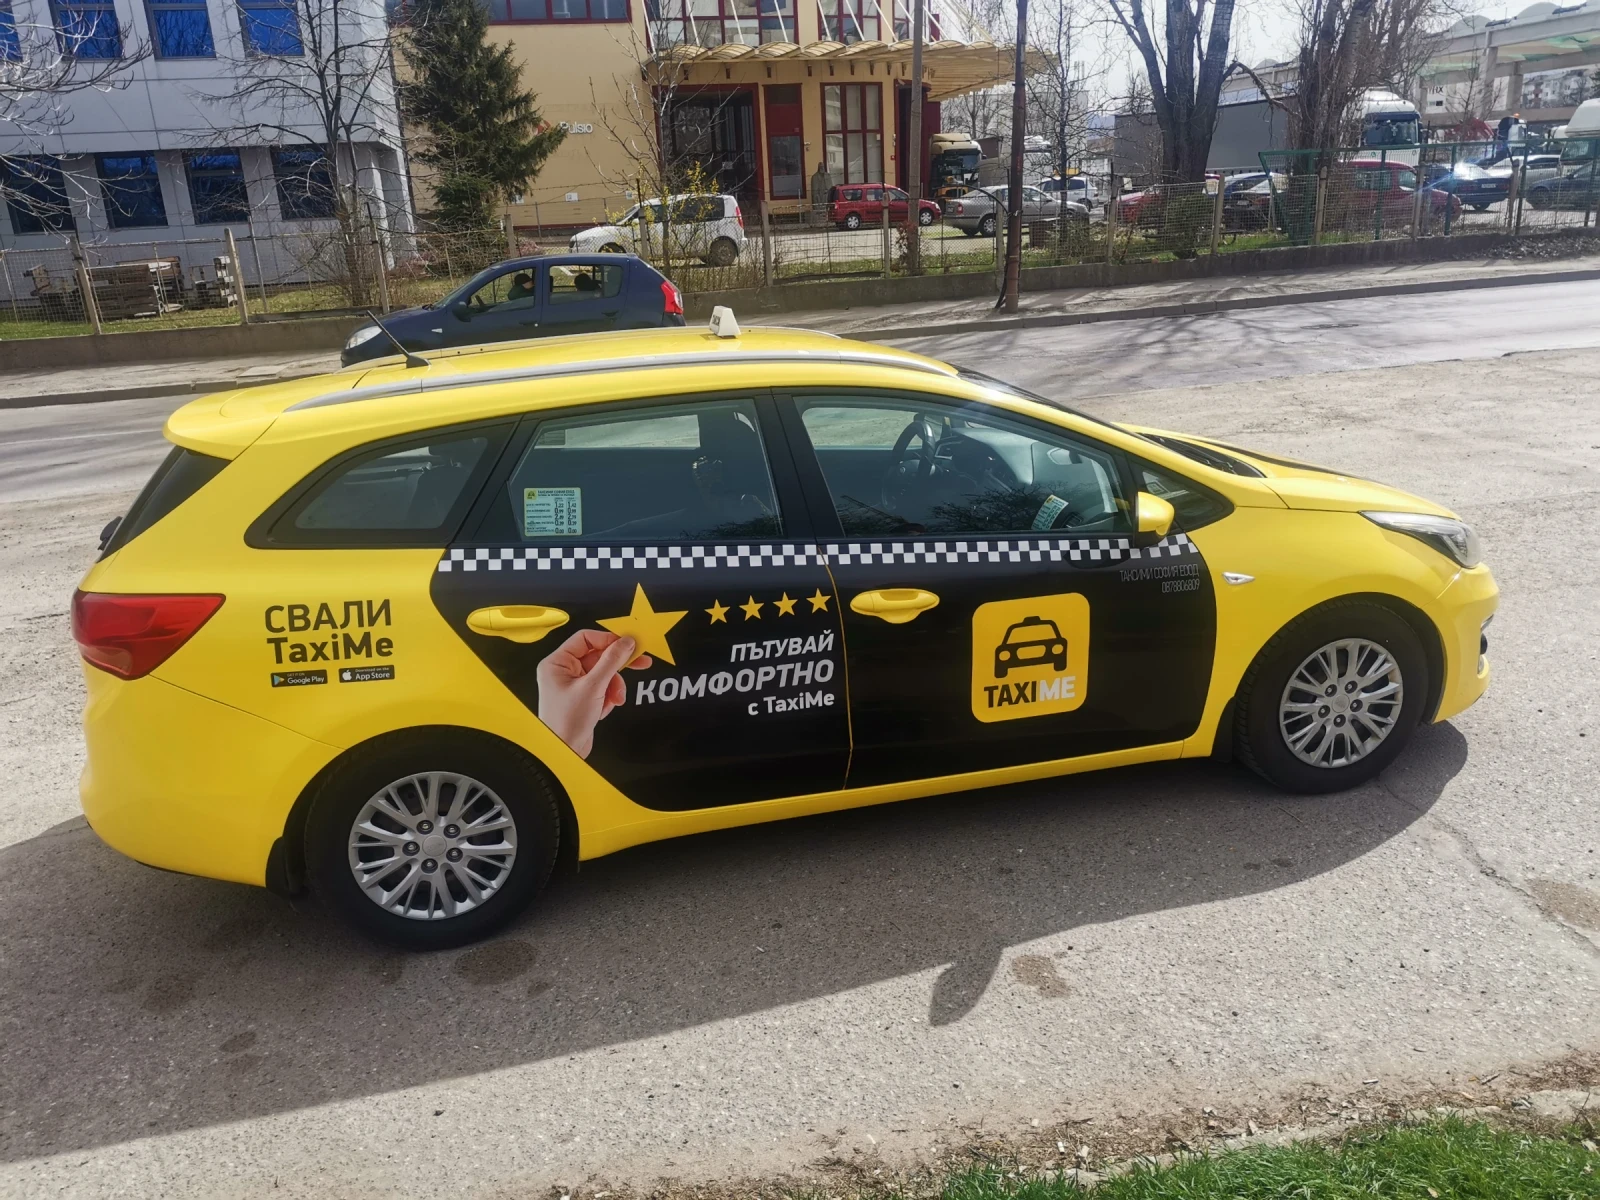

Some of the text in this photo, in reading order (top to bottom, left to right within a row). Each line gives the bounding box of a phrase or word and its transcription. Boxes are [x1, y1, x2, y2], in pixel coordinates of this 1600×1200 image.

[560, 121, 593, 134] Pulsio
[1119, 563, 1199, 582] ТАКСИМИ СОФИЯ ЕООД
[265, 598, 392, 633] СВАЛИ
[266, 631, 394, 664] TaxiMe
[730, 629, 835, 663] ПЪТУВАЙ
[287, 676, 310, 684] Google
[355, 673, 371, 681] App
[635, 659, 835, 705] КОМФОРТНО
[984, 675, 1076, 708] TAXIME
[748, 690, 835, 716] с TaxiMe
